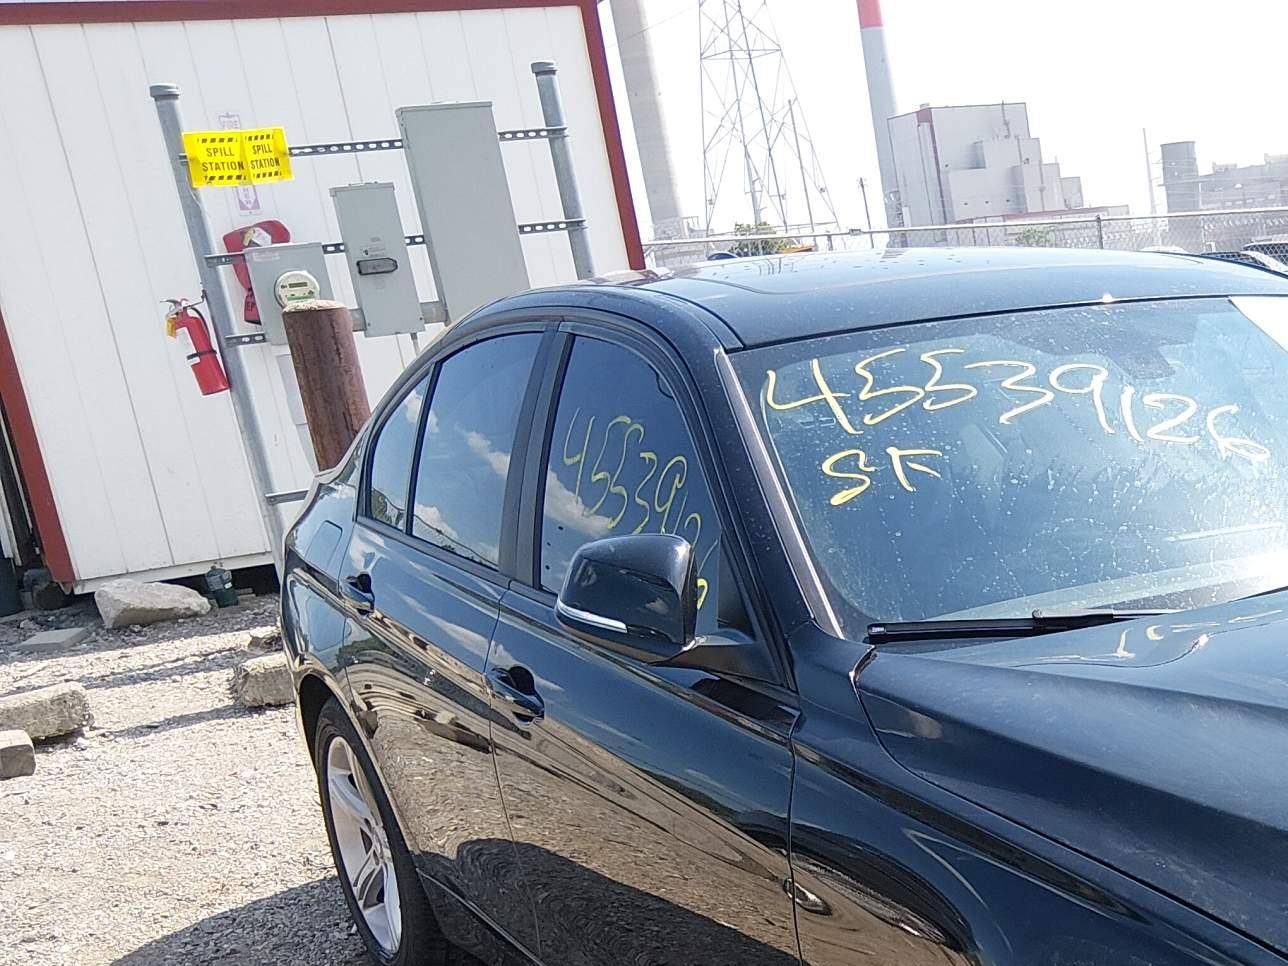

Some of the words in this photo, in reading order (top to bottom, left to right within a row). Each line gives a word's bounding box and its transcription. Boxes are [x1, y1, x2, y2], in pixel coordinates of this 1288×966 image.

[206, 147, 235, 158] SPILL
[252, 143, 273, 155] SPILL
[202, 161, 246, 172] STATION
[250, 157, 280, 170] STATION
[766, 348, 1271, 463] 45539126
[821, 447, 943, 506] SF
